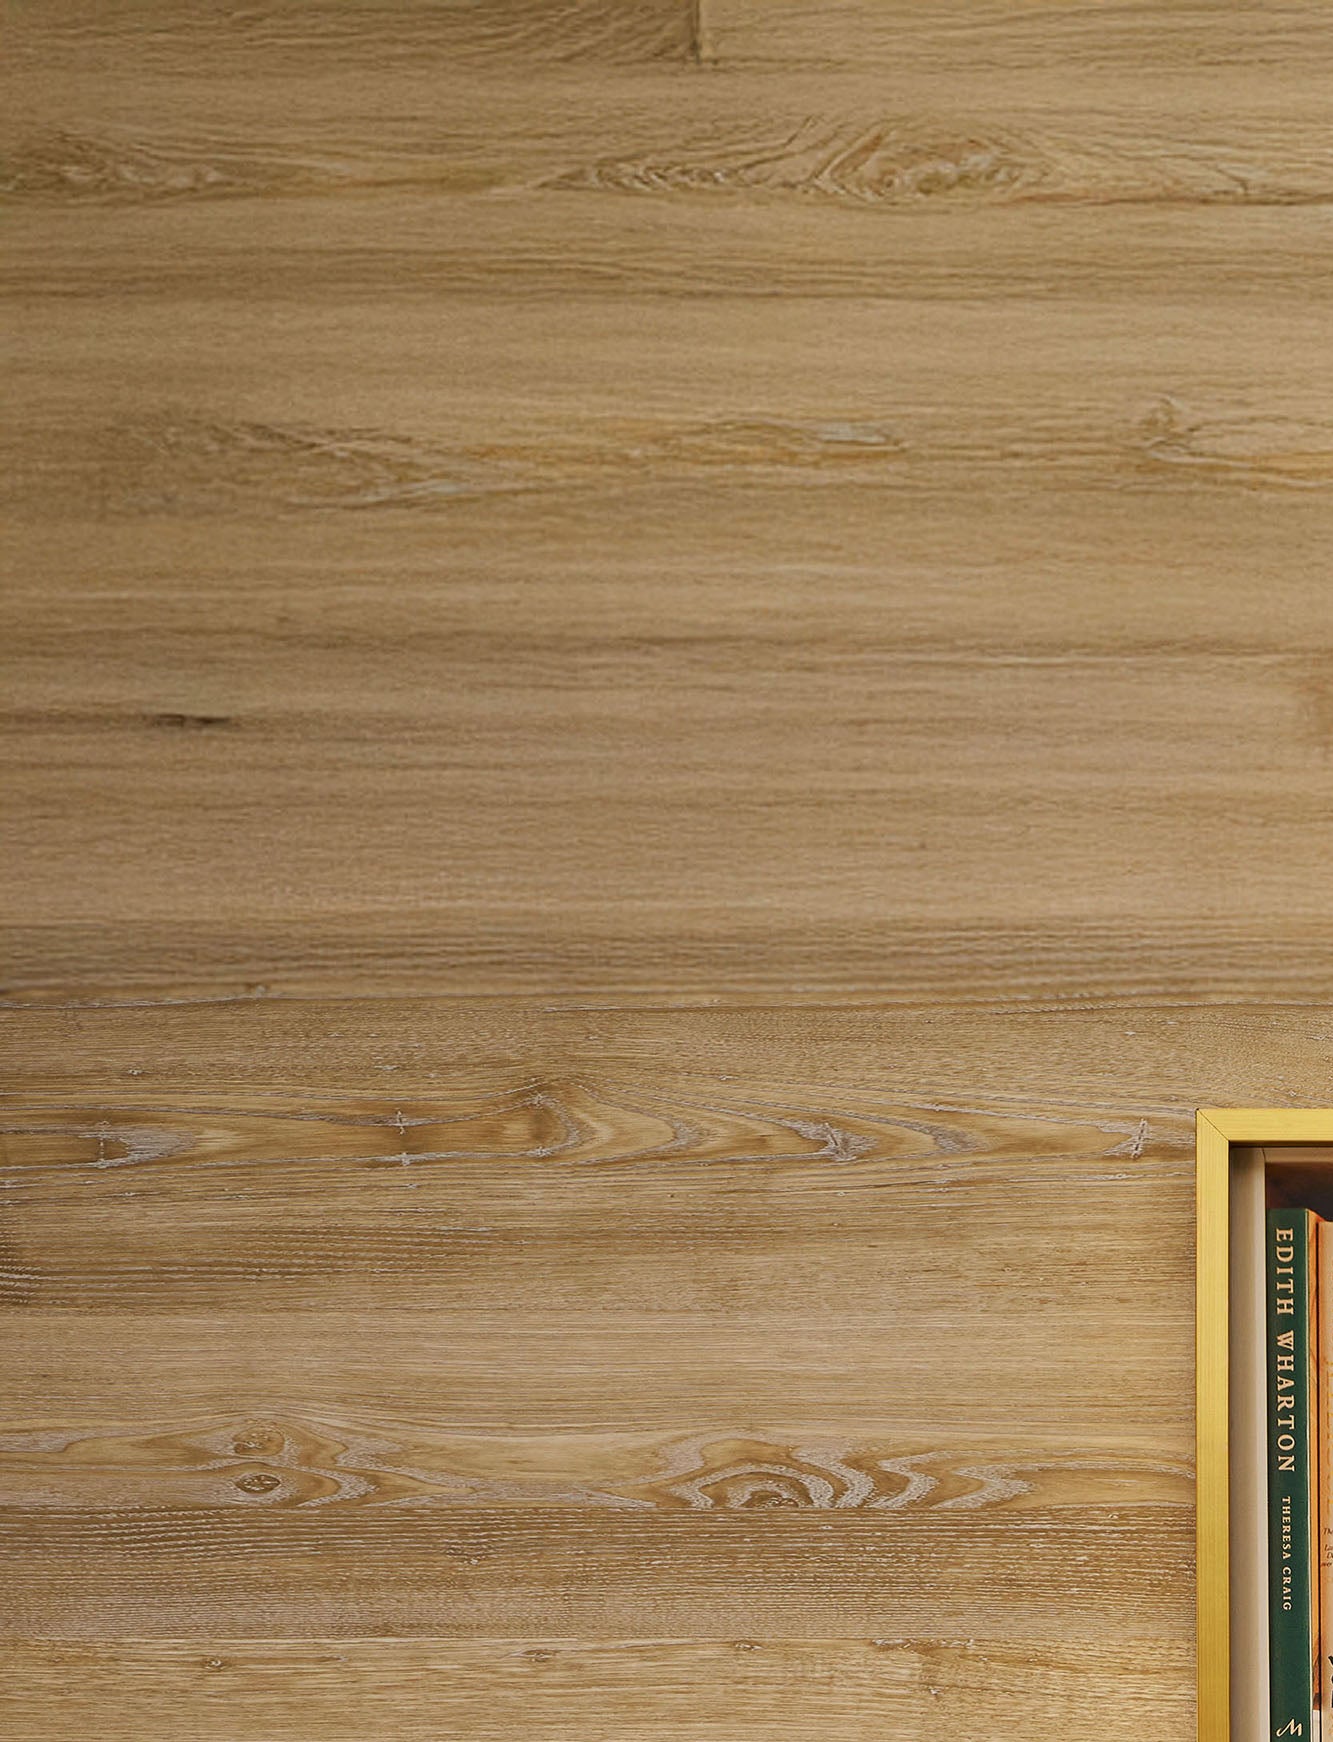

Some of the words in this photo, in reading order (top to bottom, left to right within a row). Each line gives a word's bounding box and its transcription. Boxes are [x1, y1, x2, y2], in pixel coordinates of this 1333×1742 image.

[1276, 1228, 1294, 1315] EDITH
[1276, 1330, 1295, 1472] WHARTON
[1282, 1495, 1292, 1560] THERESA
[1282, 1566, 1292, 1611] CRAIG
